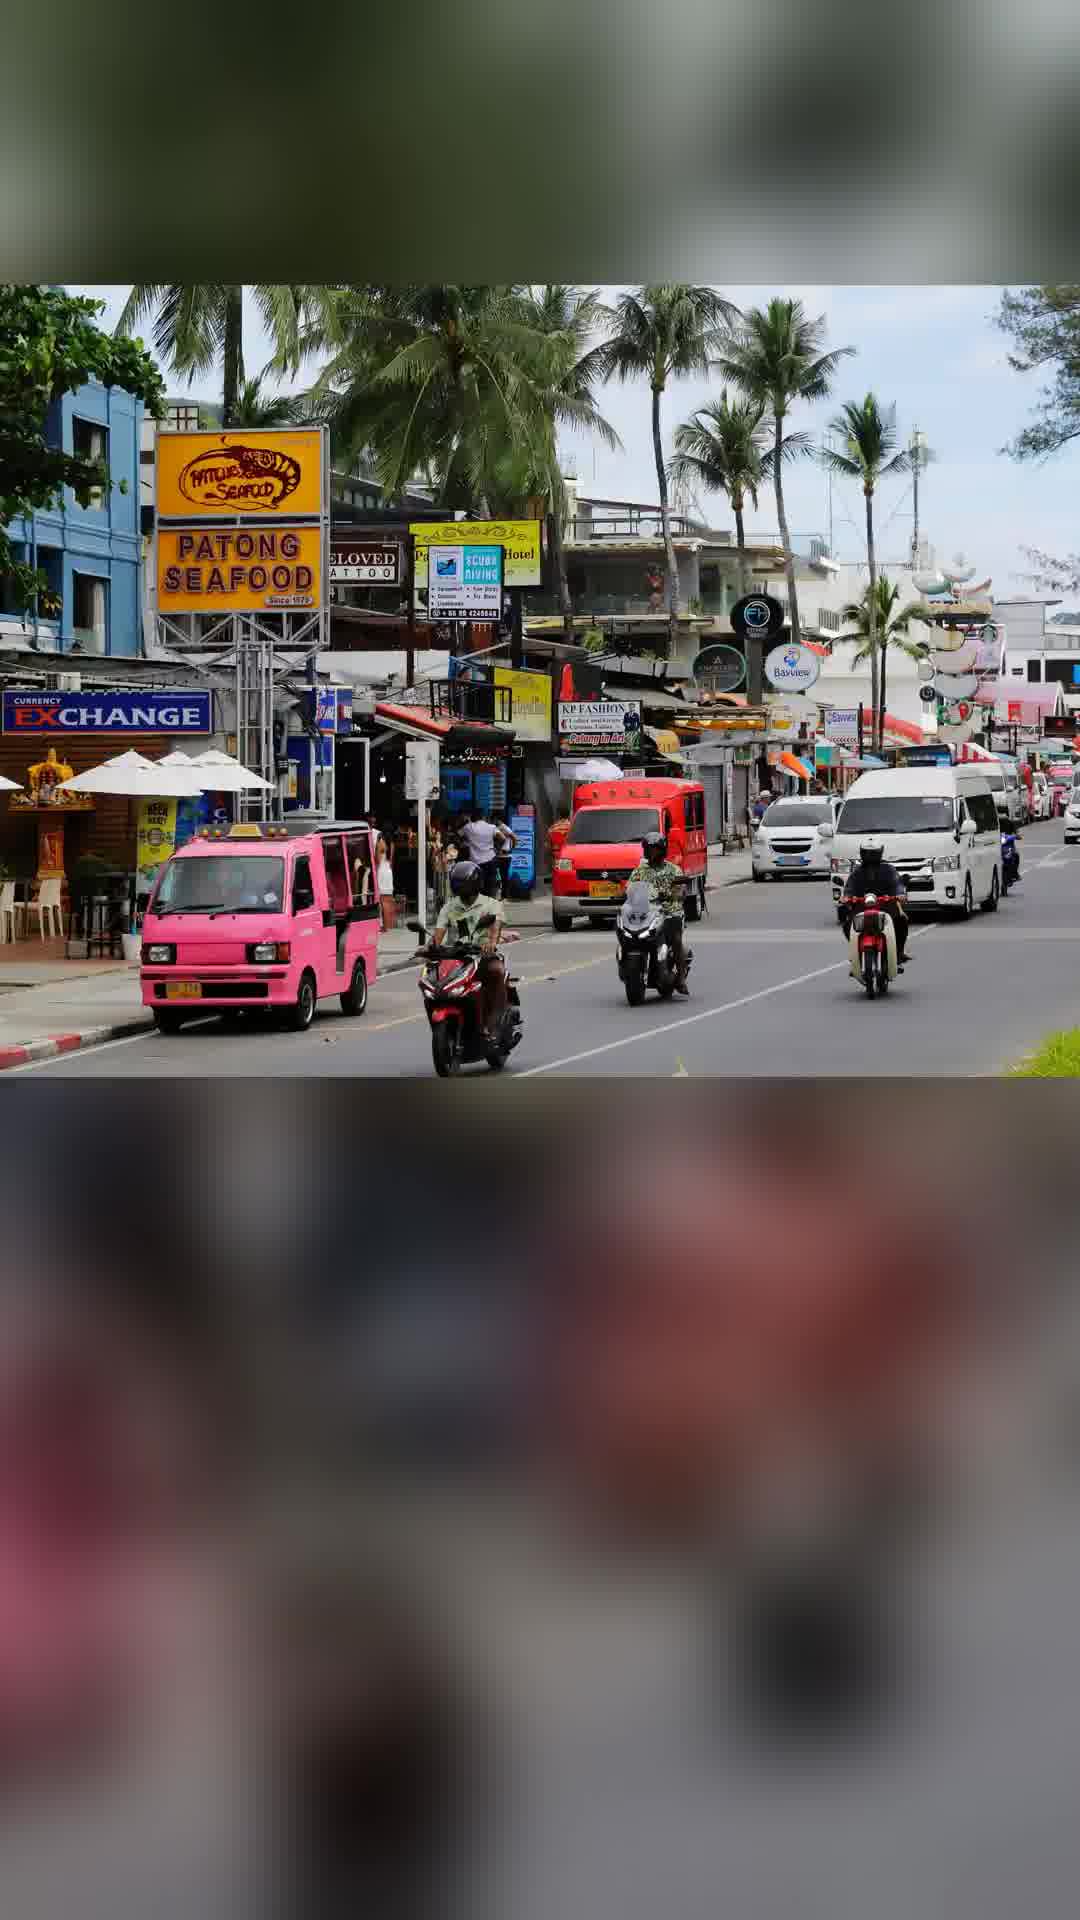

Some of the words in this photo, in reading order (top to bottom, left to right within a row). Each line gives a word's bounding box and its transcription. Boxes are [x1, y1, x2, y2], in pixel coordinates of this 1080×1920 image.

[217, 481, 275, 499] SEAFOOD
[178, 533, 300, 560] PATONG
[504, 548, 534, 560] Hotel
[165, 565, 313, 592] SEAFOOD
[774, 668, 810, 678] Bayview
[14, 697, 62, 705] CURRENCY
[579, 703, 625, 713] FASHION
[16, 708, 201, 726] EXCHANGE
